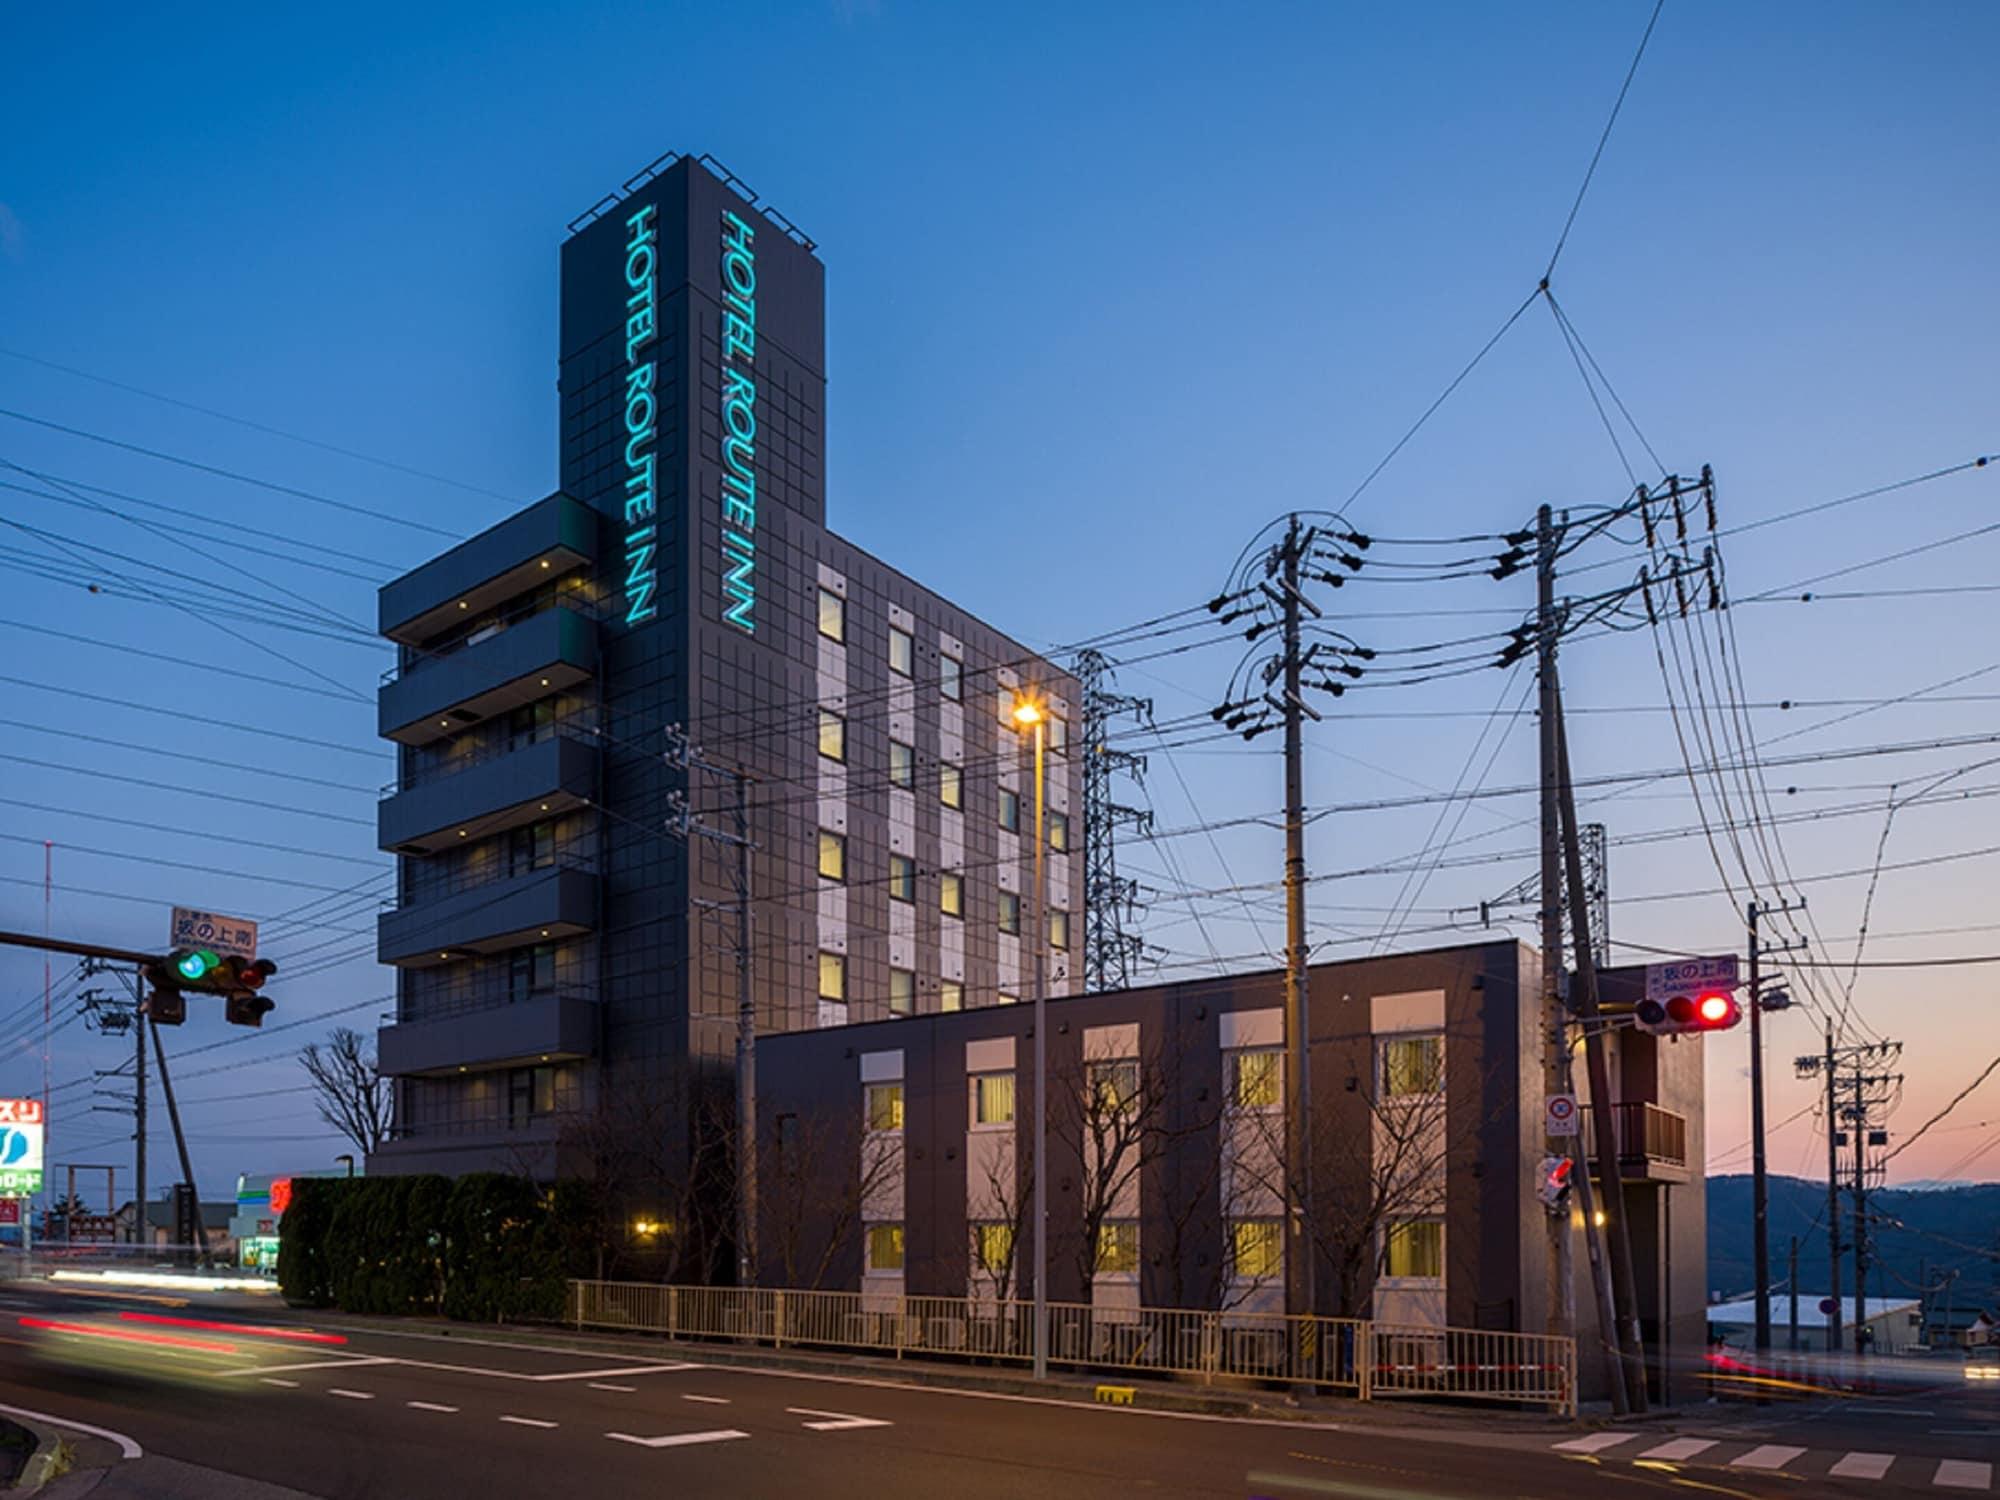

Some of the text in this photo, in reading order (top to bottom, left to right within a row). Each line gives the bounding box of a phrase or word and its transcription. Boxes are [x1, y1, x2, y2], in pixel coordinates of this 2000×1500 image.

[625, 203, 657, 627] HOTEL ROUTE INN
[721, 209, 757, 635] HOTEL ROUTE INN
[177, 919, 252, 947] 坂の上南
[1663, 960, 1734, 979] 坂の上南
[0, 1172, 42, 1189] ロード
